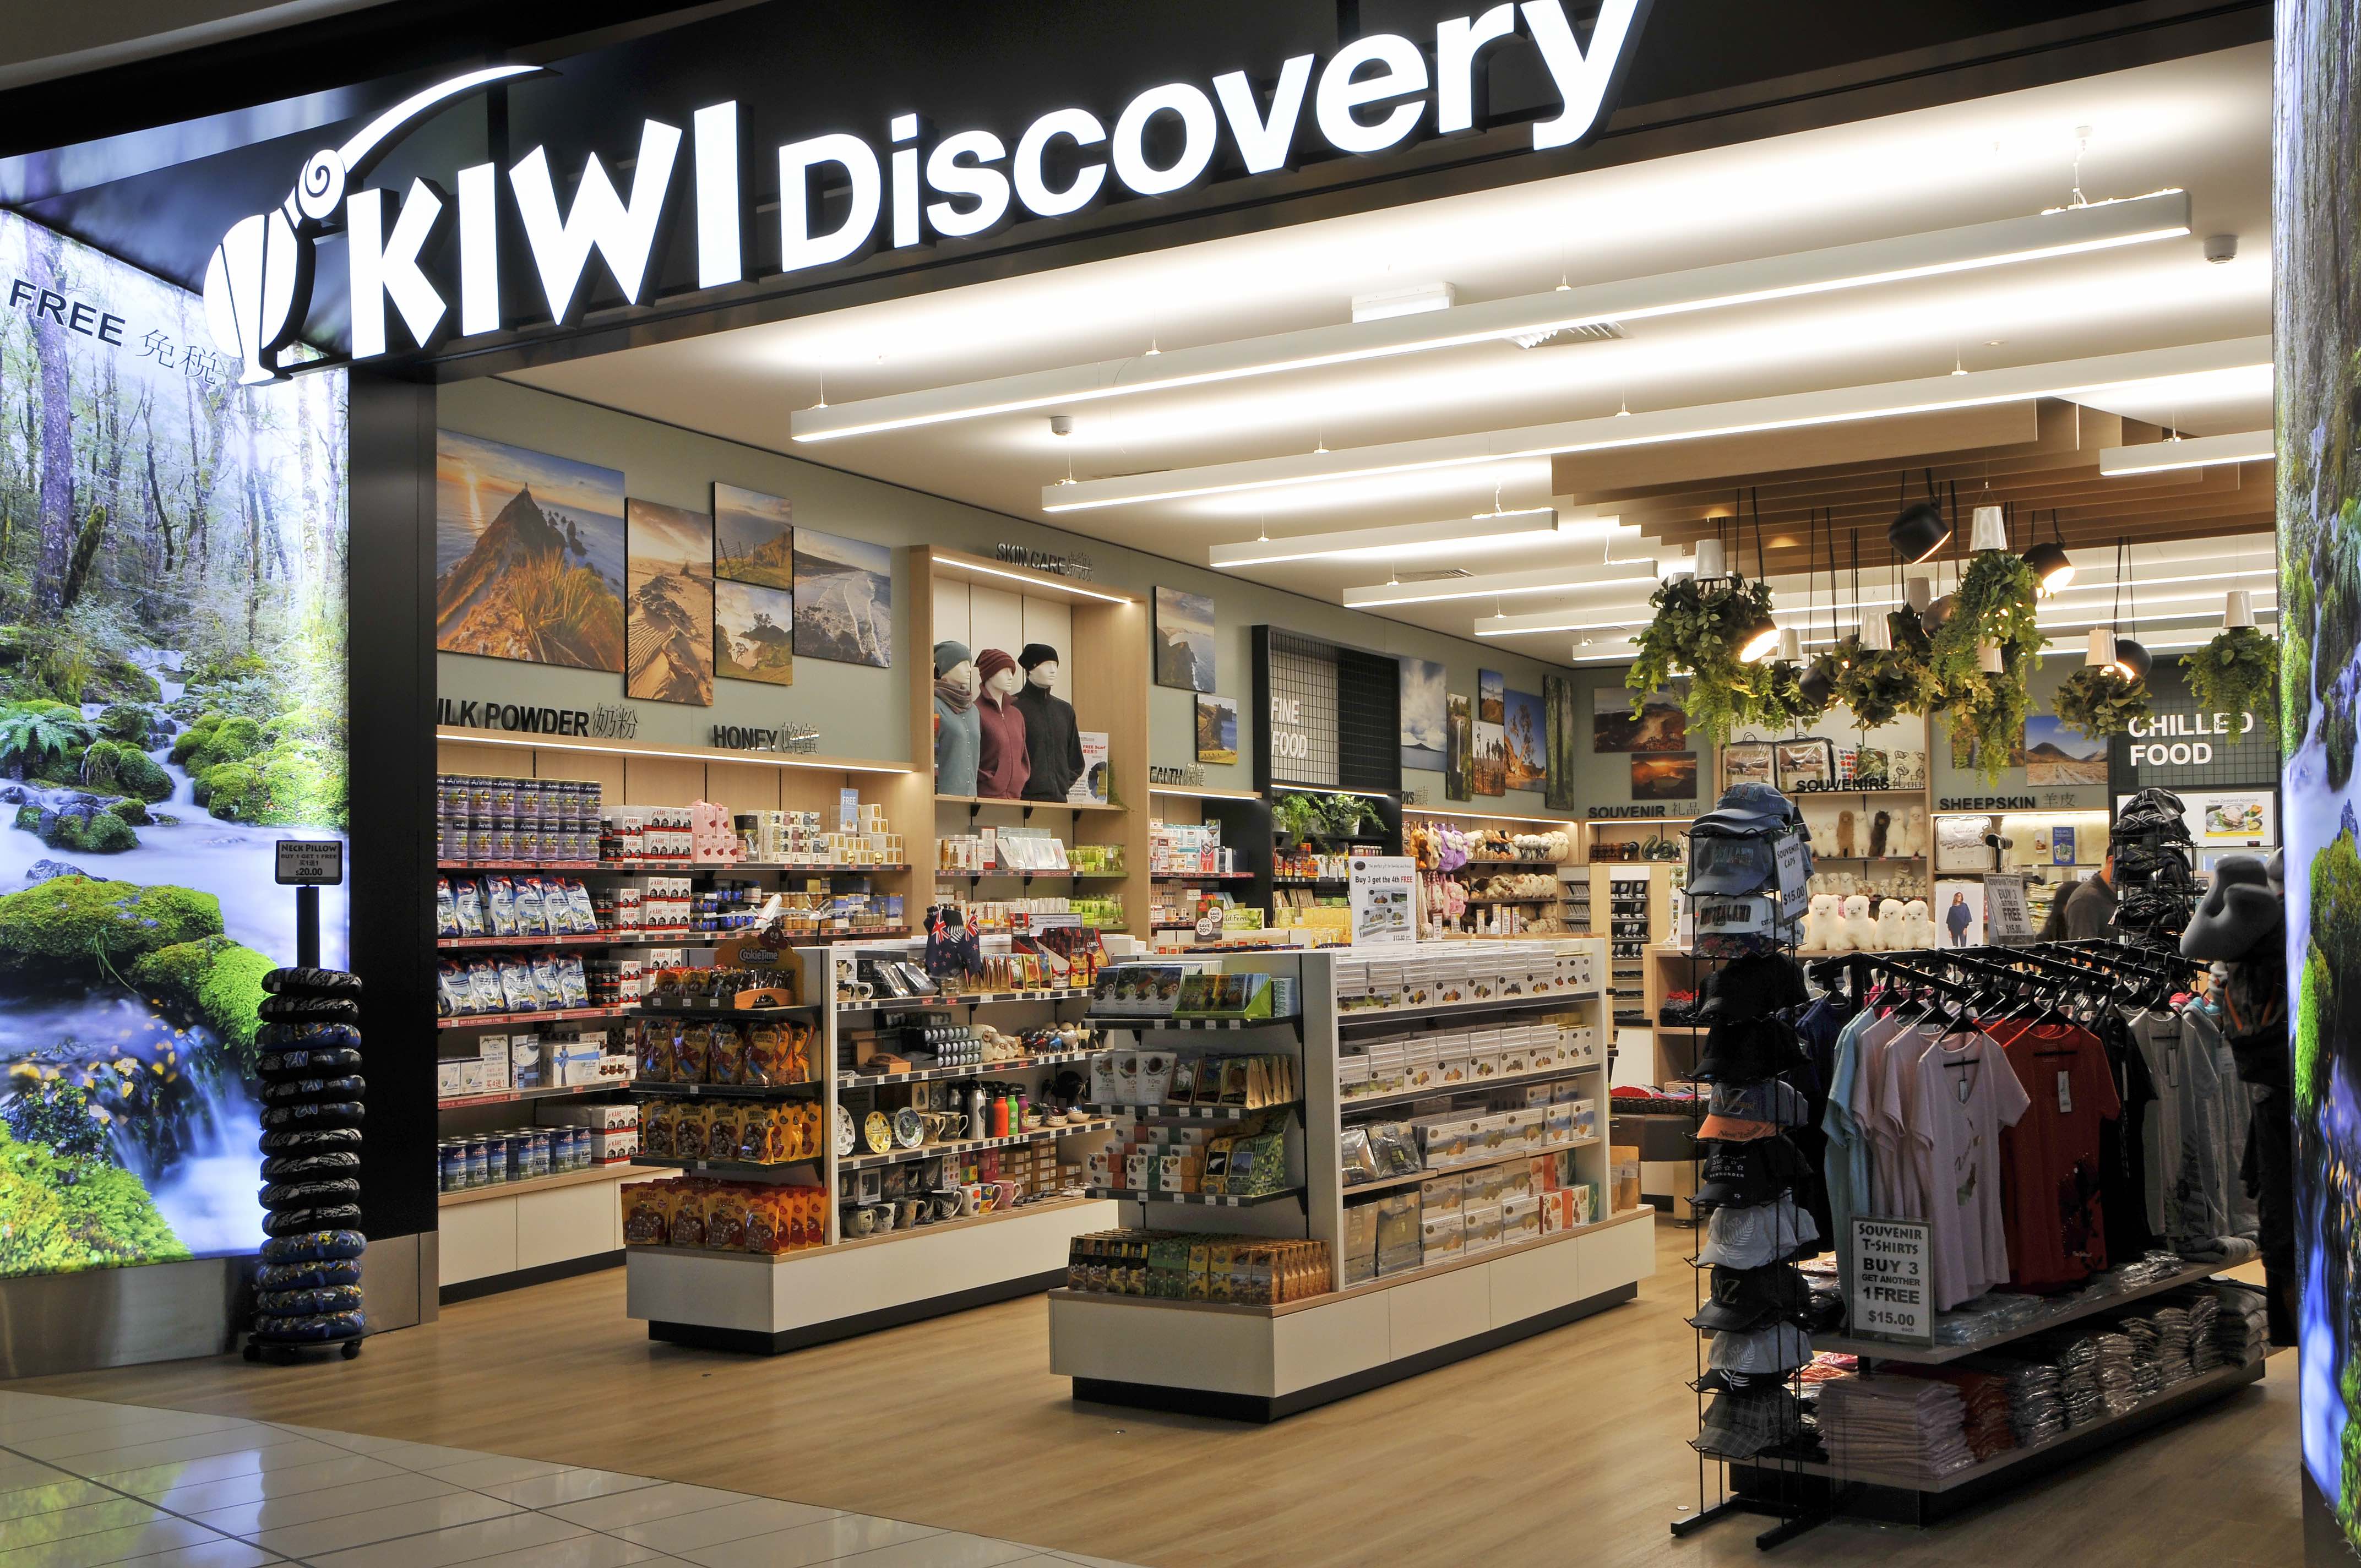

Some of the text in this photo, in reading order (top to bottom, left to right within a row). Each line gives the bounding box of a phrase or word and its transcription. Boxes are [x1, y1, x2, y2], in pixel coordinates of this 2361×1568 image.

[346, 0, 1642, 360] KIWI Discovery
[8, 279, 126, 347] FREE
[135, 329, 218, 386] 免税
[997, 542, 1066, 576] SKIN CARE
[437, 698, 590, 737] ILK POWDER
[1271, 696, 1300, 724] FINE
[592, 702, 639, 739] 奶粉
[2128, 712, 2254, 738] CHILLED
[714, 725, 777, 752] HONEY
[1271, 731, 1307, 758] FOOD
[2130, 743, 2212, 766] FOOD
[1150, 766, 1183, 786] EALTH
[1797, 777, 1890, 792] SOUVENIRS
[842, 796, 856, 805] FREE
[1401, 791, 1415, 805] OYS
[1940, 797, 2036, 810] SHEEPSKIN
[2043, 793, 2076, 808] 羊皮
[1588, 806, 1666, 818] SOUVENIR
[1672, 802, 1700, 816] 礼品
[1777, 843, 1799, 859] SOUVENIR
[1784, 857, 1796, 868] CAPS
[296, 868, 323, 876] $20.00
[1355, 876, 1366, 884] Buy
[1784, 885, 1805, 906] $15.00
[1998, 889, 2011, 899] BUY
[2003, 907, 2022, 922] FREE
[1859, 1223, 1922, 1239] SOUVENIR
[1862, 1238, 1919, 1255] T-SHIRTS
[1863, 1257, 1918, 1275] BUY 3
[1862, 1273, 1921, 1287] GET ANOTHER
[1863, 1286, 1921, 1305] 1 FREE
[1868, 1310, 1915, 1326] $15.00
